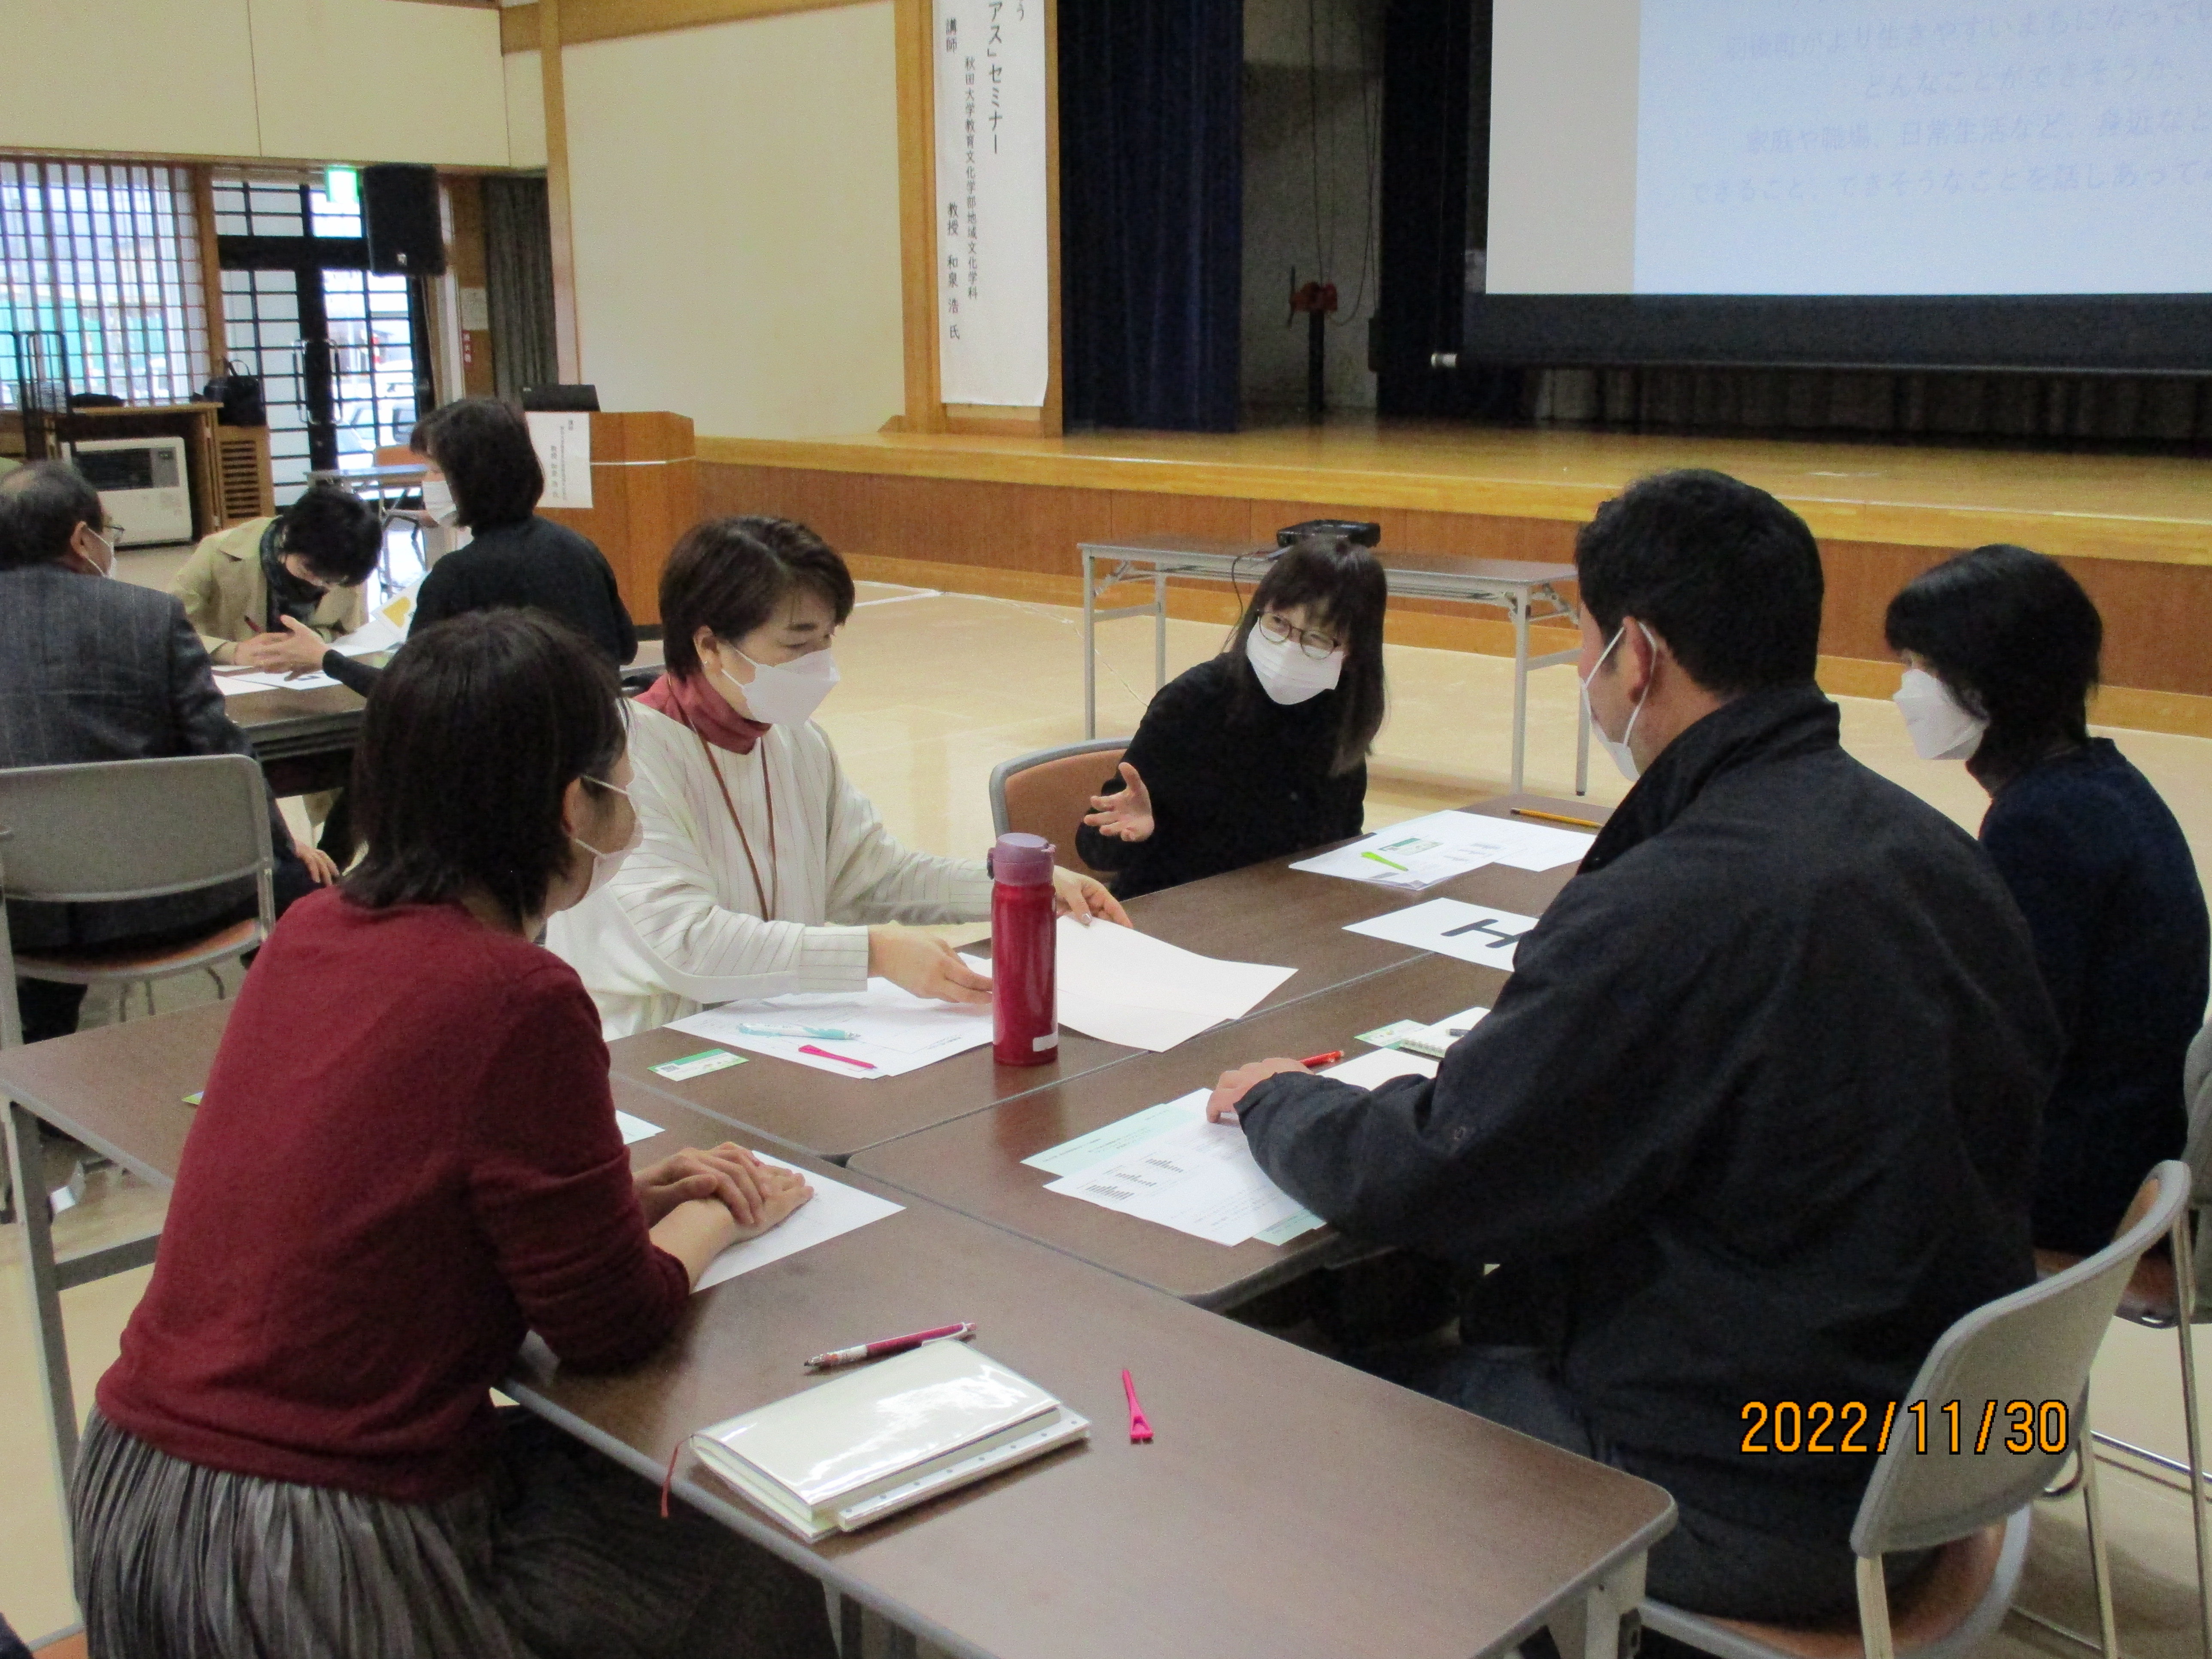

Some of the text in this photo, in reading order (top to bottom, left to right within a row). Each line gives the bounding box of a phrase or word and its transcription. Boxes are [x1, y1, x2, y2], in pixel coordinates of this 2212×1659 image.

[945, 16, 957, 53] 講師
[987, 1, 1003, 154] アス」セミナー
[965, 56, 978, 300] 秋田大学教育文化学部地域文化学科
[947, 201, 959, 237] 教授
[949, 324, 960, 340] 氏
